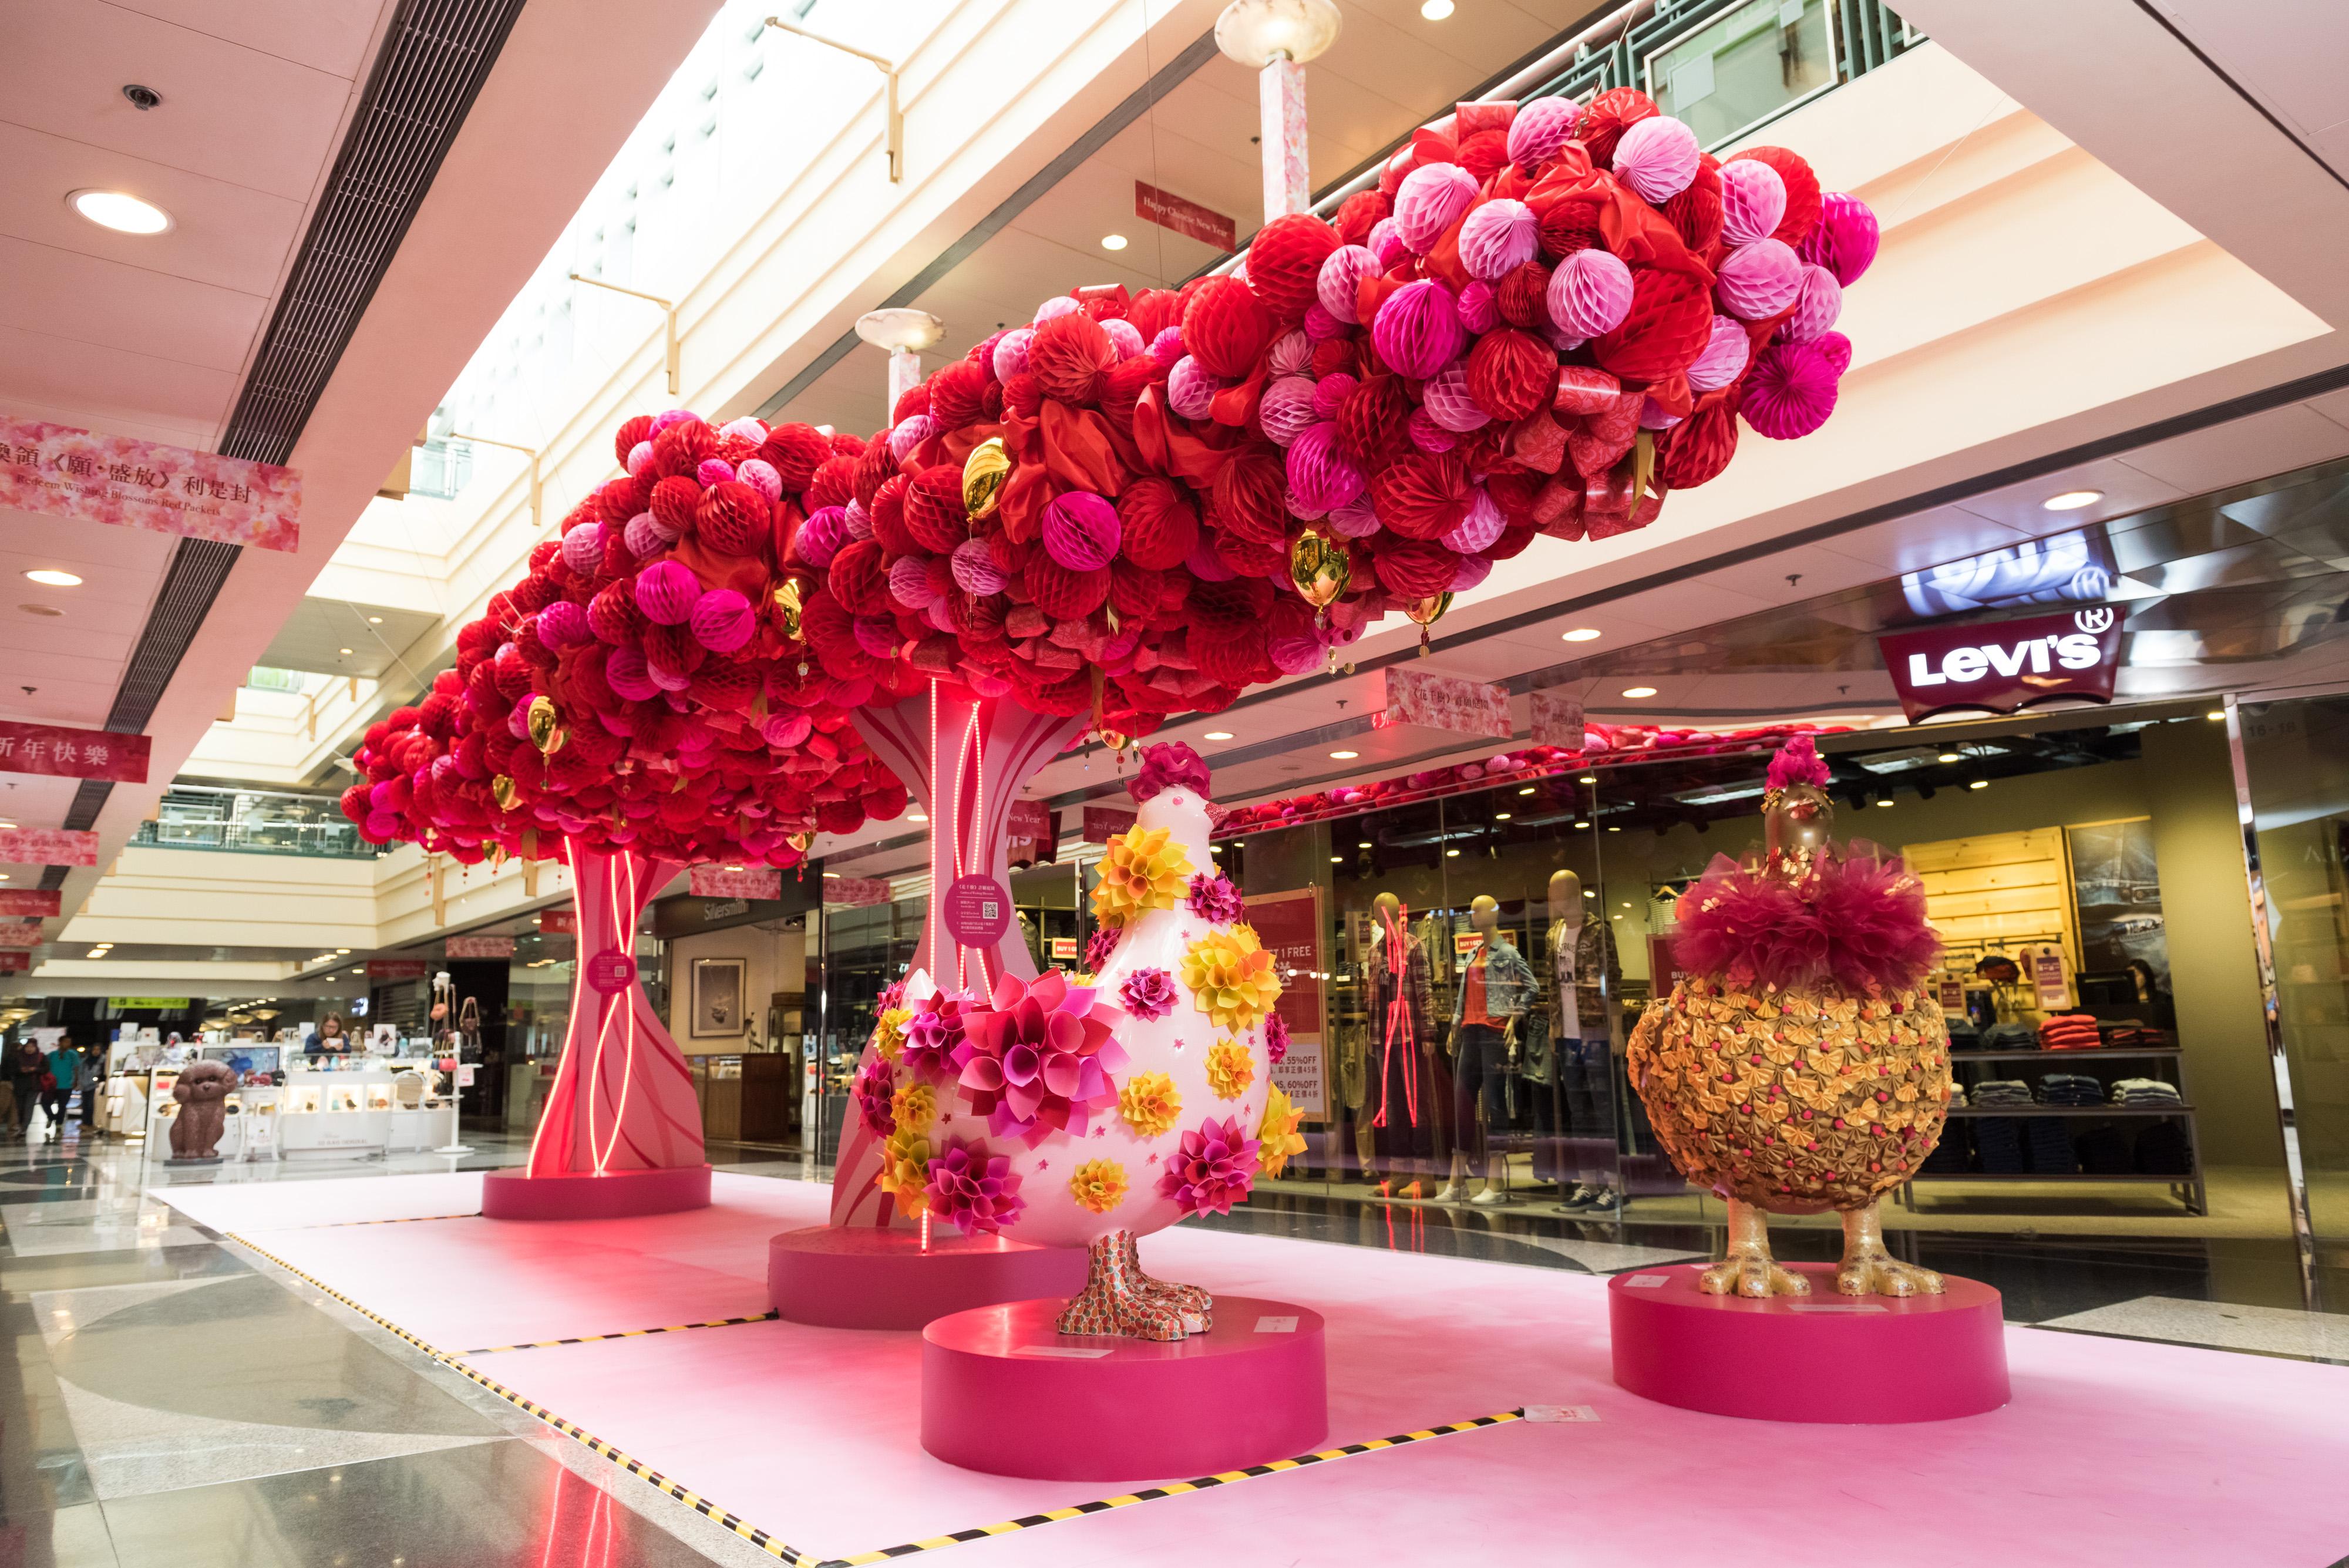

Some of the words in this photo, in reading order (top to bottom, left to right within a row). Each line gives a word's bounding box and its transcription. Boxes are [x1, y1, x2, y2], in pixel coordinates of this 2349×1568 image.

[1144, 196, 1166, 216] Happy
[1196, 218, 1211, 231] New
[1211, 224, 1228, 237] Year
[16, 474, 60, 490] Redeem
[64, 482, 108, 499] Wishing
[112, 490, 159, 506] Blossoms
[161, 498, 181, 510] Red
[184, 502, 221, 516] Packets
[1009, 813, 1023, 822] New
[1024, 814, 1041, 823] Year
[1281, 948, 1285, 958] 1
[1287, 945, 1311, 958] FREE
[1287, 1056, 1317, 1064] 55%OFF
[1288, 1080, 1318, 1088] 60%OFF
